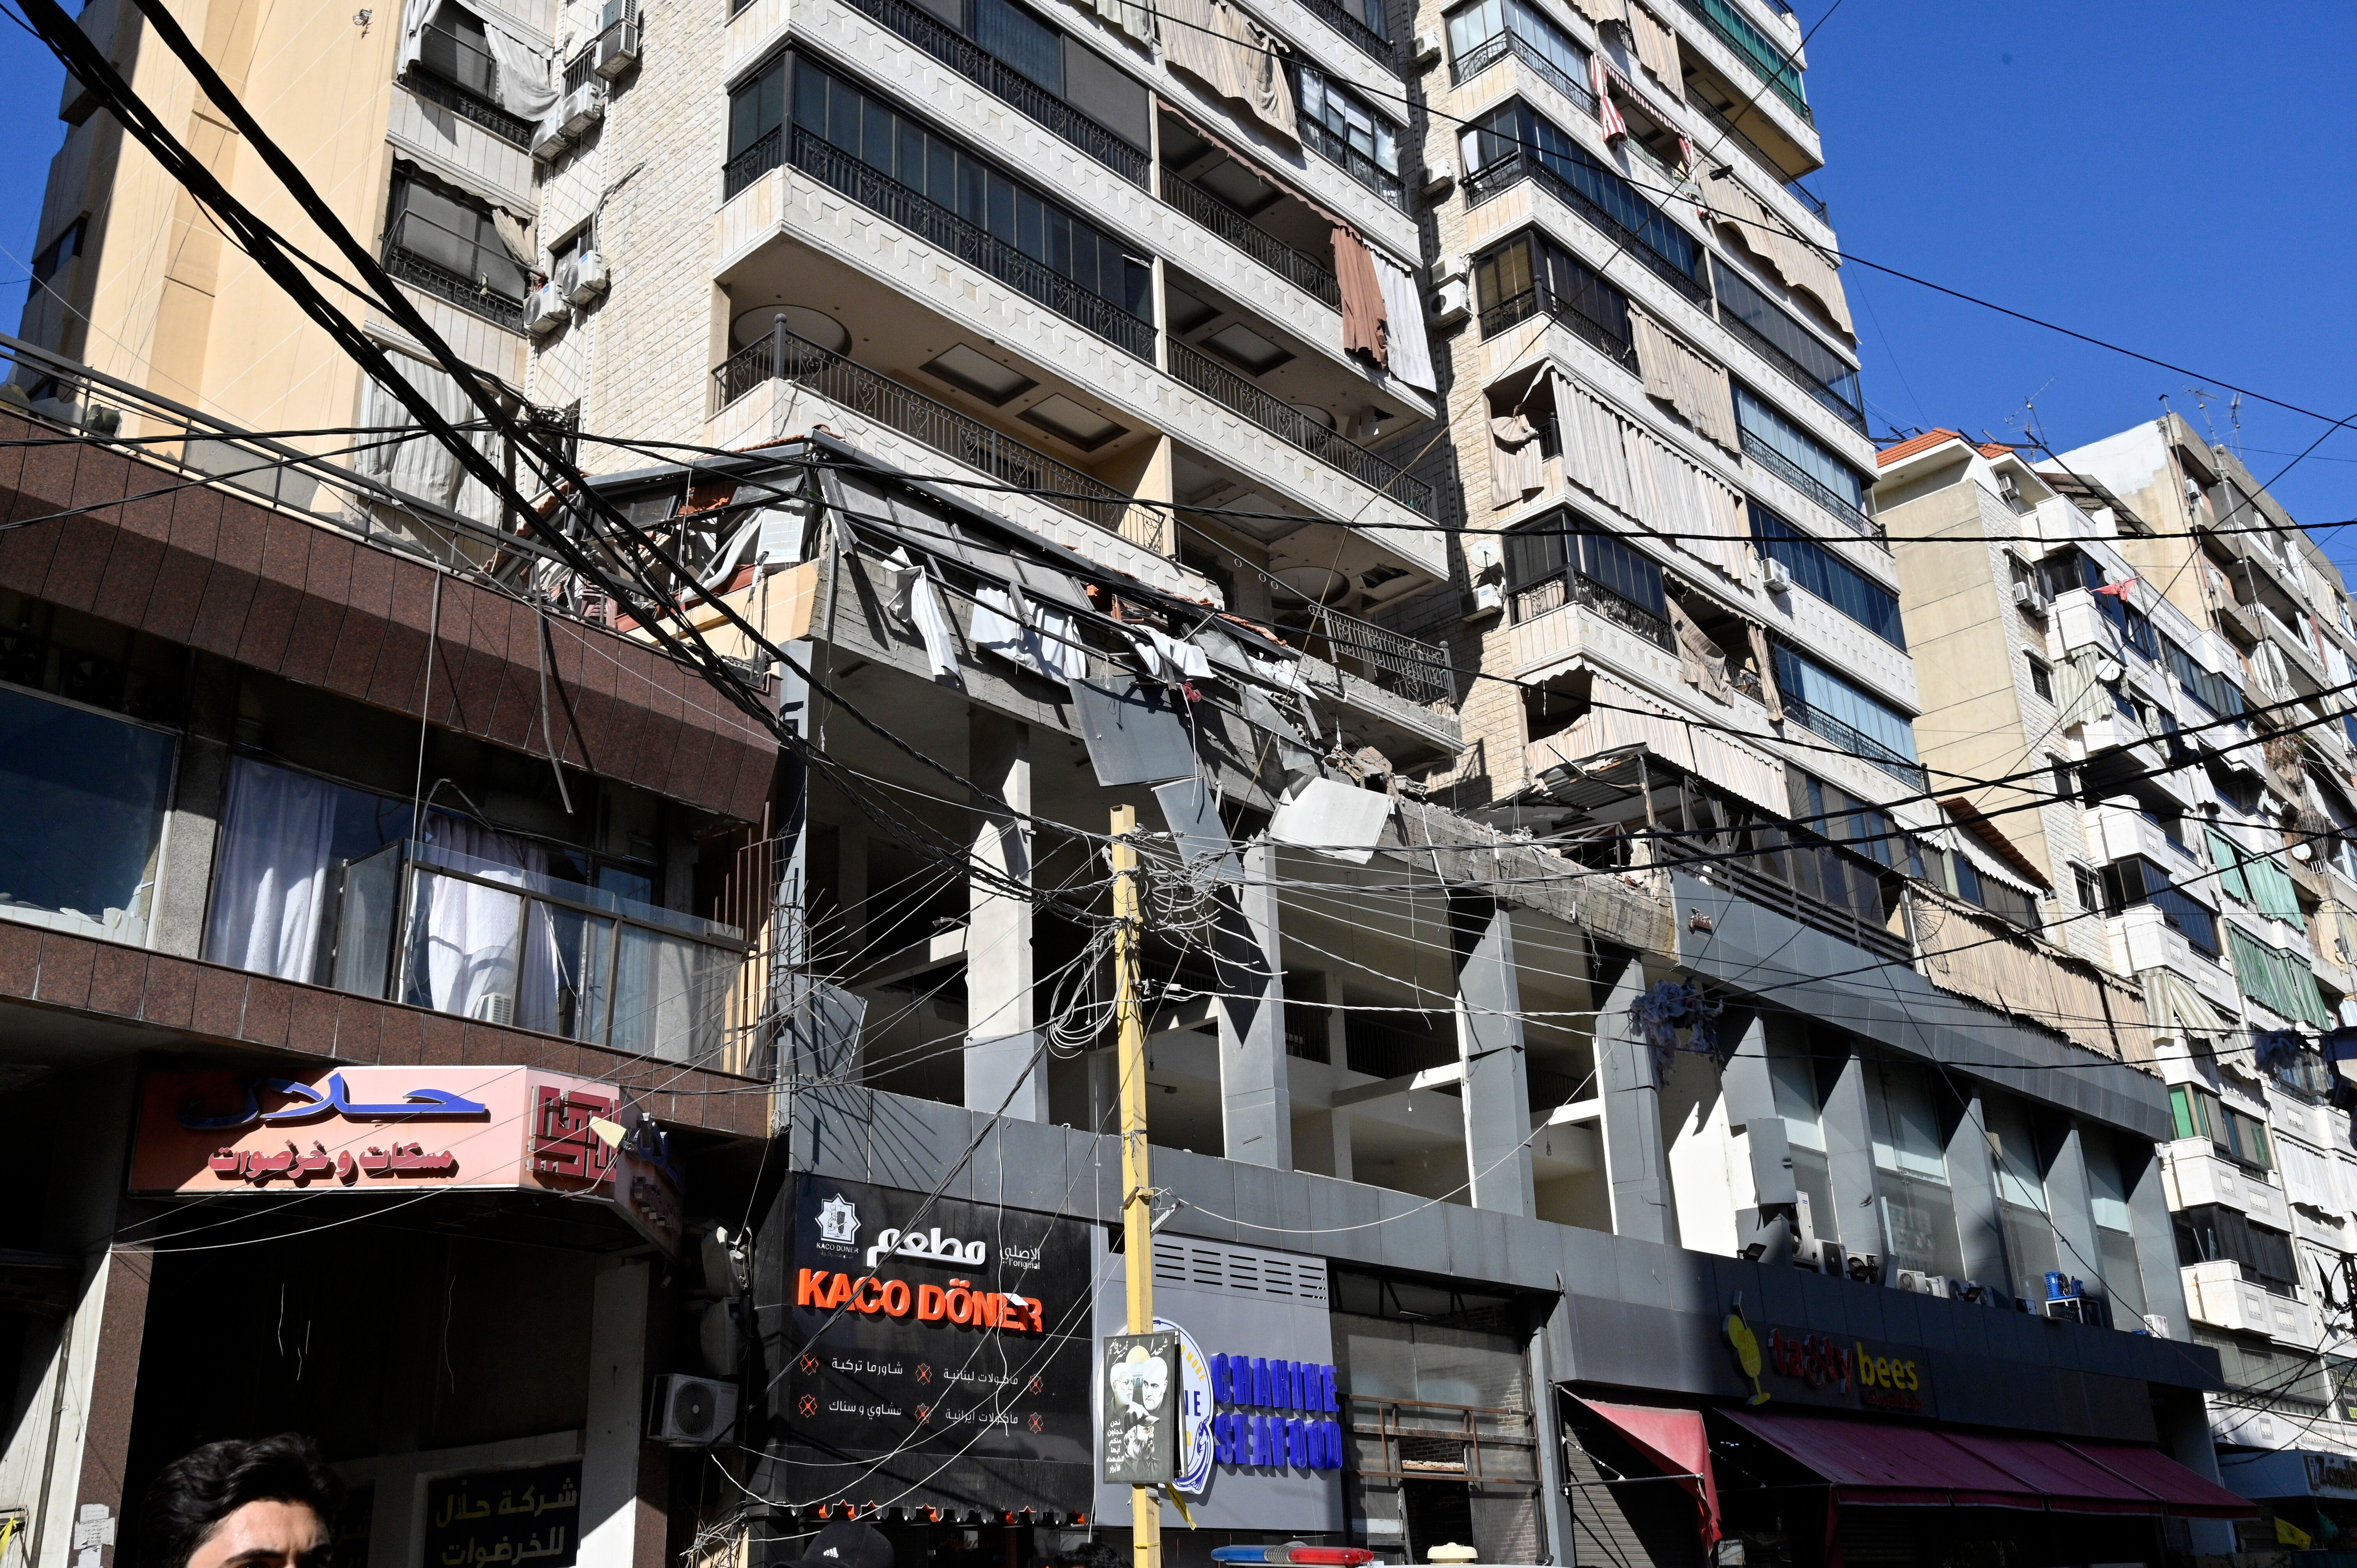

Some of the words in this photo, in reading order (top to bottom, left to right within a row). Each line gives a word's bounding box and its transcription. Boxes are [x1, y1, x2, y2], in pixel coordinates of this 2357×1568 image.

[335, 1150, 353, 1178] و
[359, 1142, 455, 1169] مسكات
[816, 1242, 835, 1250] KACO
[836, 1244, 859, 1254] DÖNER
[867, 1227, 986, 1269] مطعم
[1009, 1259, 1040, 1270] l'original
[798, 1268, 911, 1317] KACO
[918, 1278, 1043, 1332] DÖNER
[832, 1358, 862, 1373] تركية
[867, 1361, 903, 1376] شاورما
[1186, 1351, 1206, 1382] MORE
[1768, 1328, 1853, 1394] tasty
[1853, 1341, 1919, 1391] bees
[943, 1368, 974, 1384] لبنانية
[1210, 1353, 1339, 1412] CHAHINE
[829, 1401, 856, 1412] سناك
[859, 1405, 864, 1416] و
[867, 1402, 901, 1420] مشاوي
[1110, 1419, 1121, 1428] نحن
[1214, 1412, 1343, 1469] SEAFOOD
[498, 1477, 577, 1518] شركة
